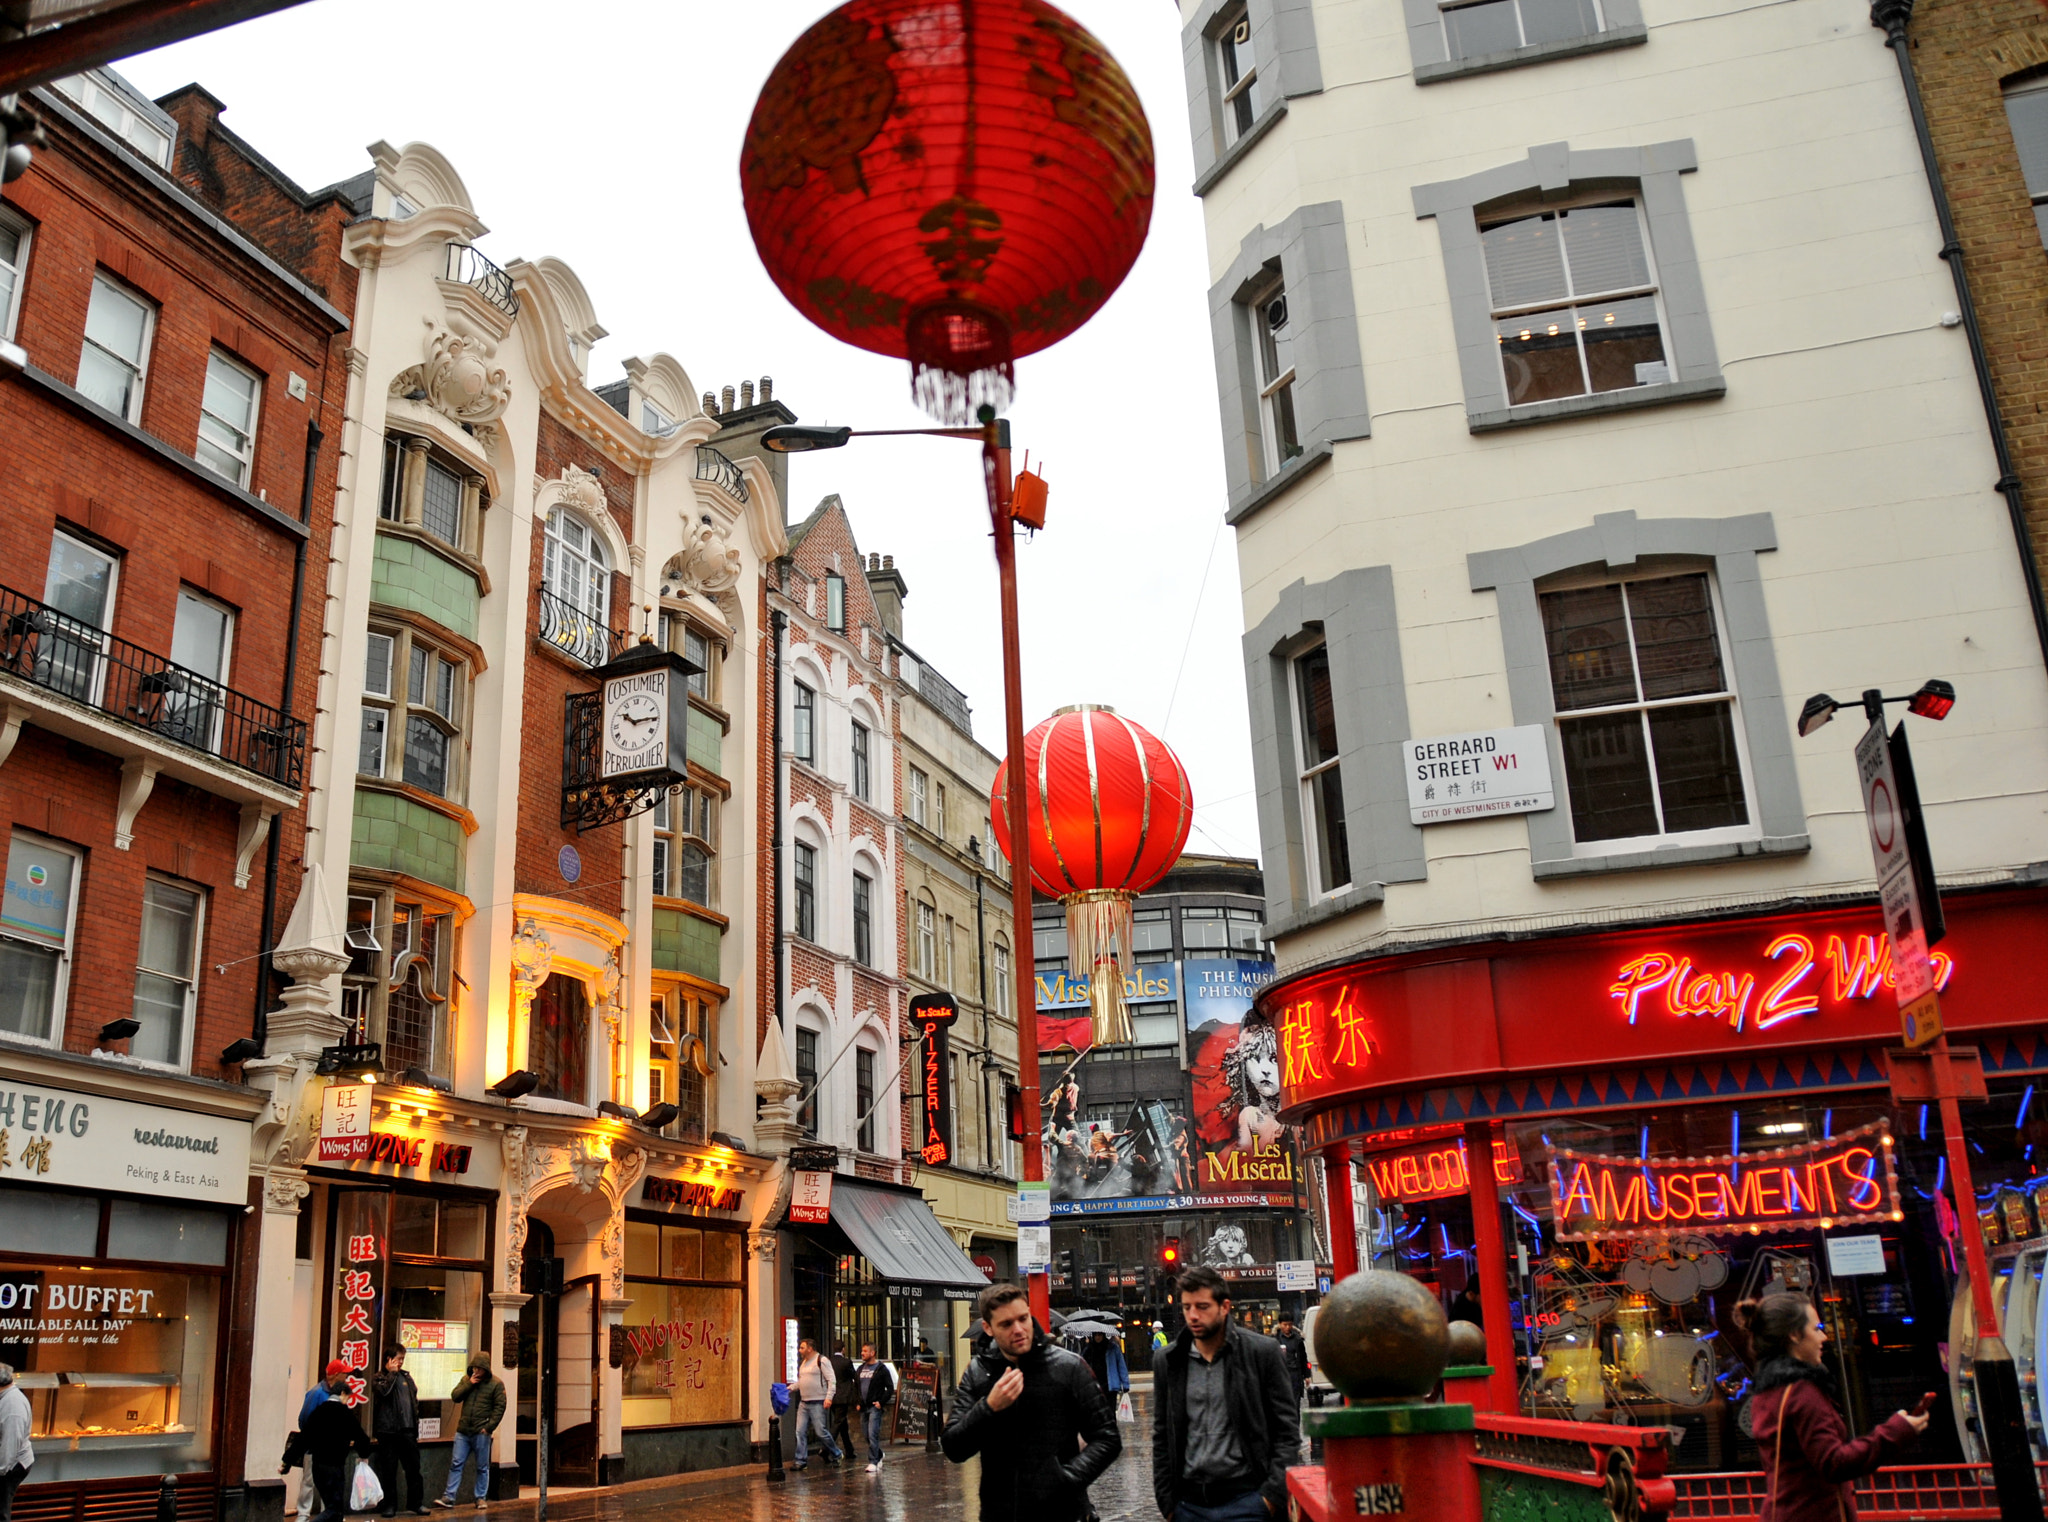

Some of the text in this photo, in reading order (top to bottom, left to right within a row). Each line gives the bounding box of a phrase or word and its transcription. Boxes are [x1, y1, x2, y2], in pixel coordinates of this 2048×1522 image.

[607, 672, 666, 705] COSTUMIER
[604, 741, 664, 775] PERRUQUIER
[1415, 736, 1496, 761] GERRARD
[1417, 753, 1518, 781] STREET W1
[1863, 747, 1884, 784] ZONE
[1422, 800, 1511, 819] CITY OF WESTMINSTER
[1201, 970, 1236, 983] THE
[1610, 953, 1754, 1033] Play
[1756, 934, 1819, 1030] 2
[924, 1022, 941, 1144] PIZZERIA
[336, 1088, 357, 1134] 旺記
[134, 1127, 219, 1155] restaurant
[321, 1138, 368, 1157] Wong Kei
[921, 1142, 945, 1158] OPEN
[1252, 1134, 1281, 1158] Les
[434, 1141, 473, 1174] KEI
[926, 1150, 947, 1165] LATE
[1369, 1141, 1515, 1199] WELCOE
[126, 1164, 219, 1188] Peking & East Asia
[803, 1173, 821, 1205] 旺記
[1562, 1147, 1882, 1223] AMUSEMENTS
[645, 1177, 746, 1212] RESTAURANT
[1084, 1201, 1114, 1210] HAPPY
[1117, 1199, 1166, 1209] BIRTHDAY
[1179, 1195, 1193, 1207] 30
[1195, 1196, 1225, 1205] YEARS
[1226, 1195, 1260, 1204] YOUNG
[792, 1207, 828, 1221] Wong Kei
[47, 1284, 155, 1314] BUFFET
[0, 1317, 73, 1331] AVAILABLE
[74, 1318, 100, 1331] ALL
[627, 1314, 694, 1358] Wong
[700, 1319, 730, 1361] Kei
[2, 1335, 19, 1344] eat
[38, 1333, 63, 1344] much
[68, 1335, 79, 1343] as
[82, 1335, 99, 1346] you
[102, 1333, 119, 1344] like
[655, 1357, 705, 1390] 旺記
